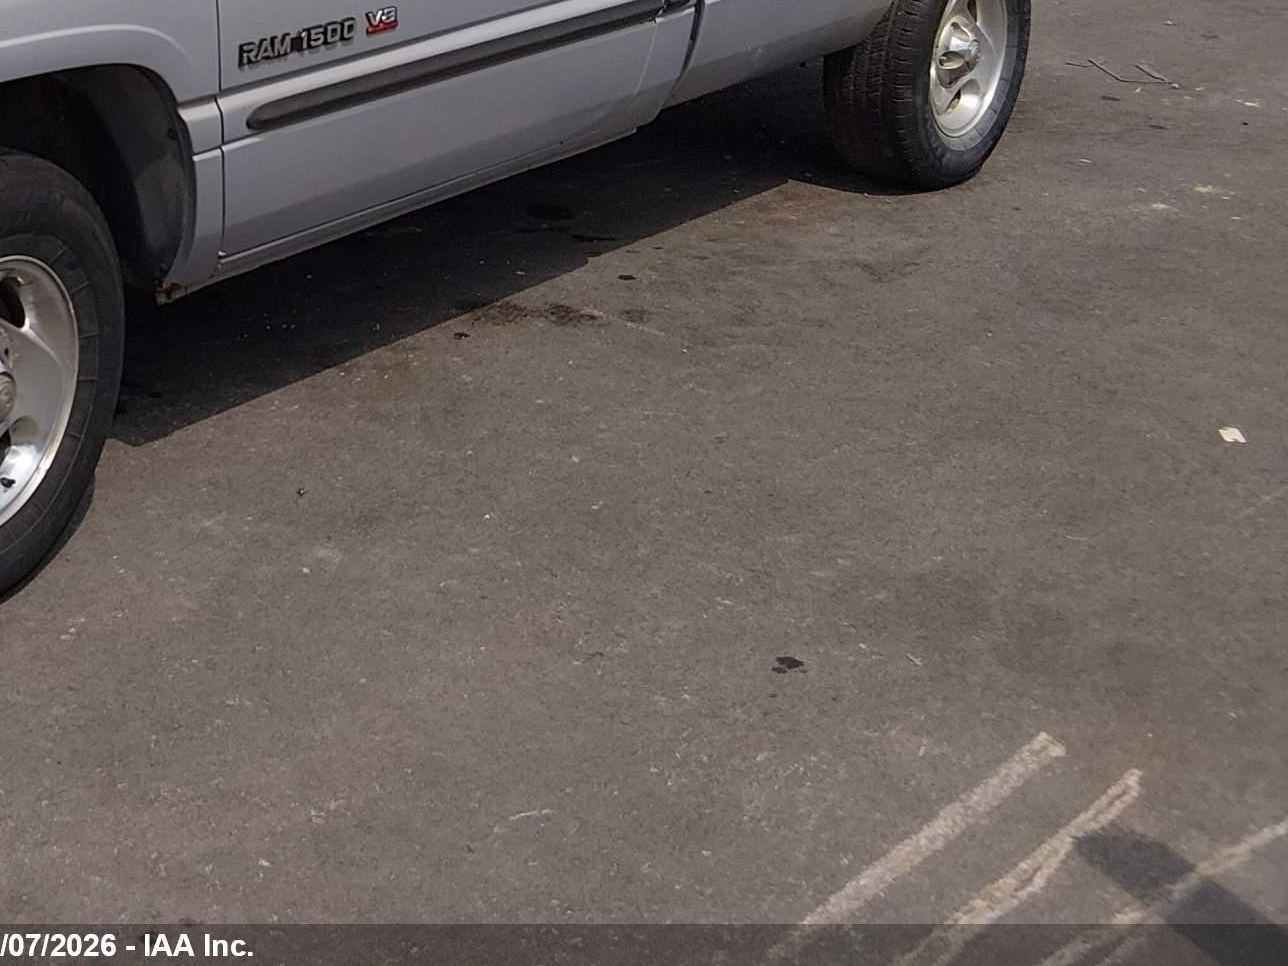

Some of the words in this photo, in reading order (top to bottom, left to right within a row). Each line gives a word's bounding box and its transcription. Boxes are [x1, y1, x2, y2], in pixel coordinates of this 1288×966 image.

[239, 33, 292, 66] RAM
[298, 17, 357, 50] 1500
[365, 6, 398, 29] V8
